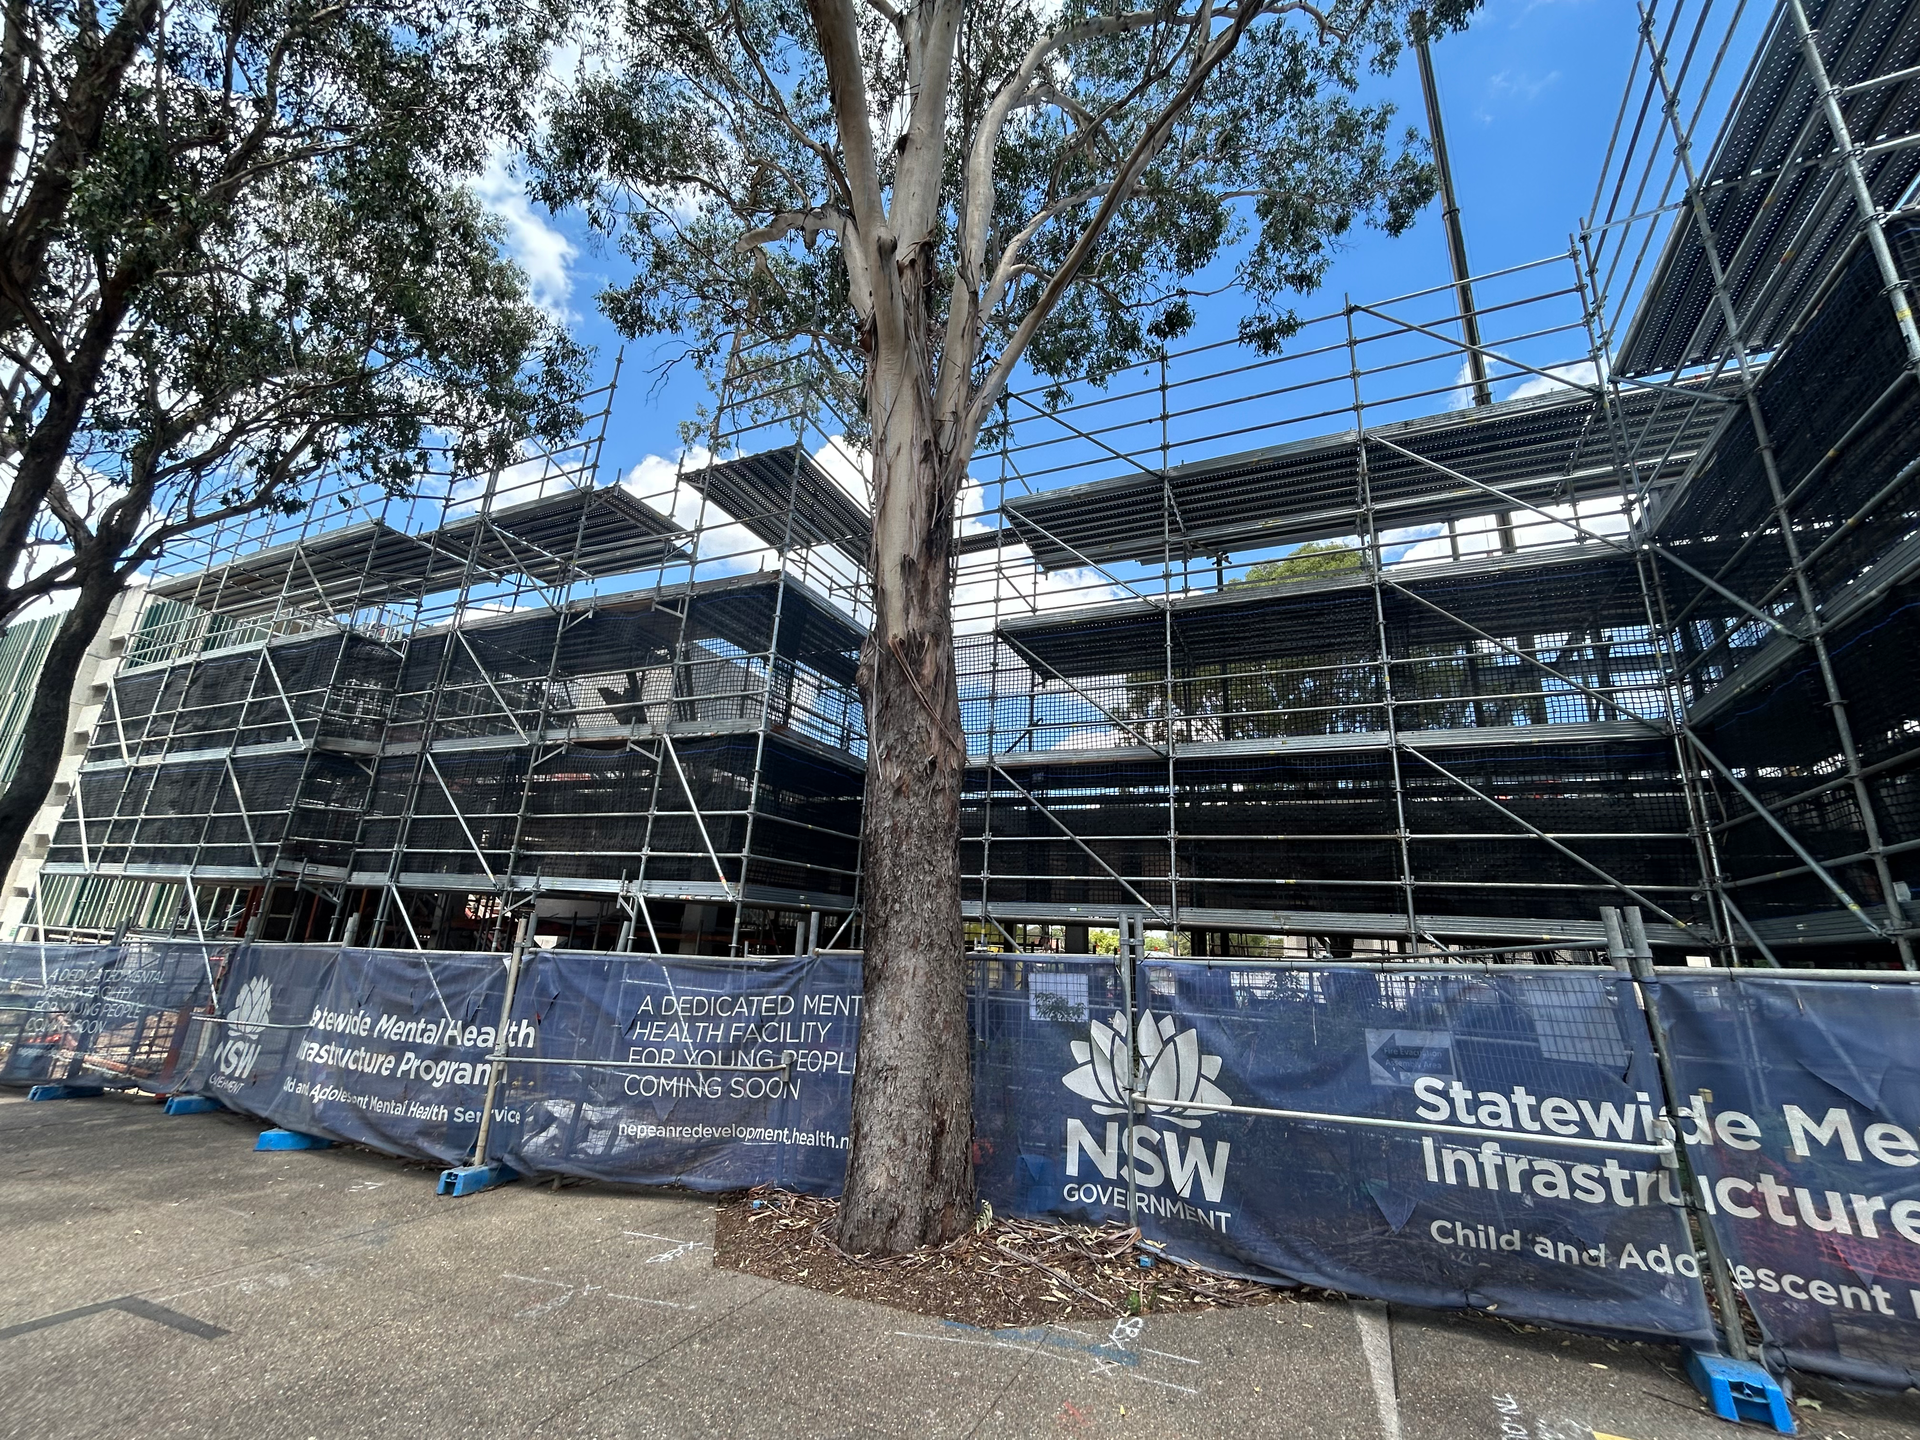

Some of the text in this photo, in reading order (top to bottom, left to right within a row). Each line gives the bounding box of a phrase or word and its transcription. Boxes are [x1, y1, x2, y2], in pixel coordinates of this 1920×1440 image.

[47, 967, 166, 984] A DEDICATED MENTAL
[100, 1003, 141, 1019] PEOPLE
[637, 995, 655, 1016] A
[661, 995, 795, 1017] DEDICATED
[71, 1019, 107, 1034] SOON
[373, 1013, 446, 1046] Mental
[632, 1020, 833, 1043] HEALTH FACILITY
[214, 1040, 262, 1079] NSW
[628, 1047, 676, 1067] FOR
[683, 1048, 774, 1069] YOUNG
[1384, 1047, 1399, 1055] Fire
[1385, 1059, 1442, 1070] Assembly Area
[624, 1074, 801, 1100] COMING SOON
[369, 1096, 407, 1116] Mental
[407, 1101, 449, 1122] Health
[453, 1106, 521, 1125] Service
[1413, 1076, 1762, 1151] Statewide
[1065, 1118, 1231, 1203] NSW
[1063, 1182, 1231, 1234] GOVERNMENT
[1430, 1219, 1521, 1251] Child
[1533, 1235, 1606, 1268] and
[1618, 1242, 1895, 1316] Adolescent
